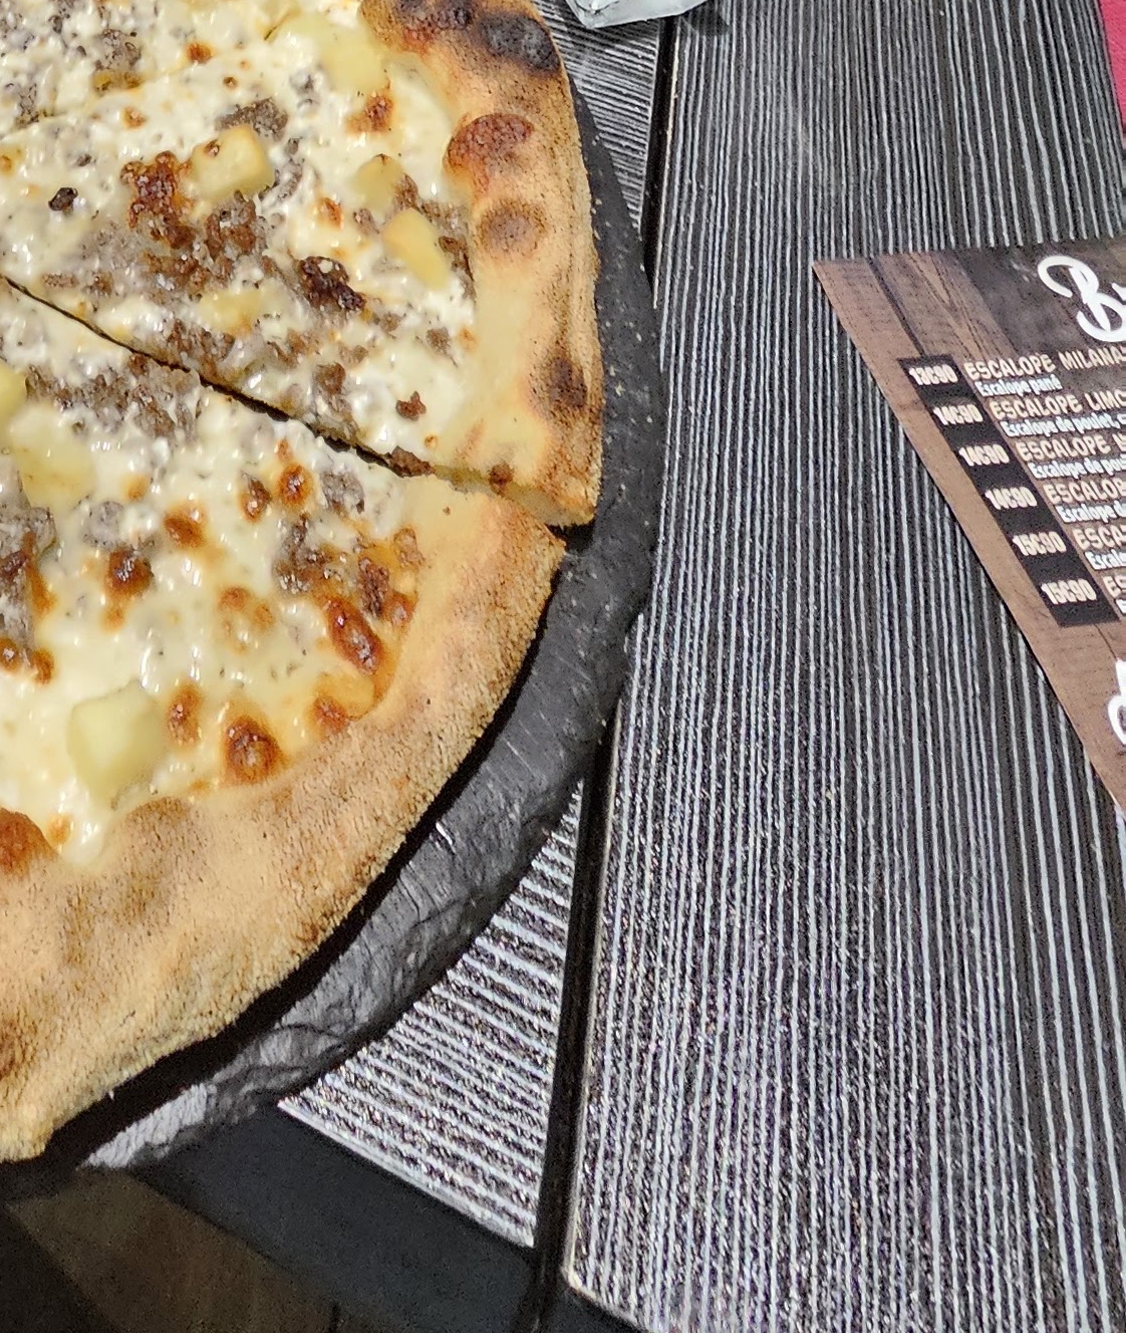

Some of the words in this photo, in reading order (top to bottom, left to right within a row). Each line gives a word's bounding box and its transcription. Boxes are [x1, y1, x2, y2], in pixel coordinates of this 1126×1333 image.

[965, 353, 1056, 381] ESCALOPE
[974, 379, 1031, 398] Escalope
[989, 393, 1083, 421] ESCALOPE
[999, 418, 1056, 438] Escalope
[1055, 416, 1075, 433] de
[1015, 434, 1111, 462] ESCALOPE
[1027, 459, 1086, 479] Escalope
[1083, 456, 1104, 474] de
[1054, 502, 1117, 524] Escalope
